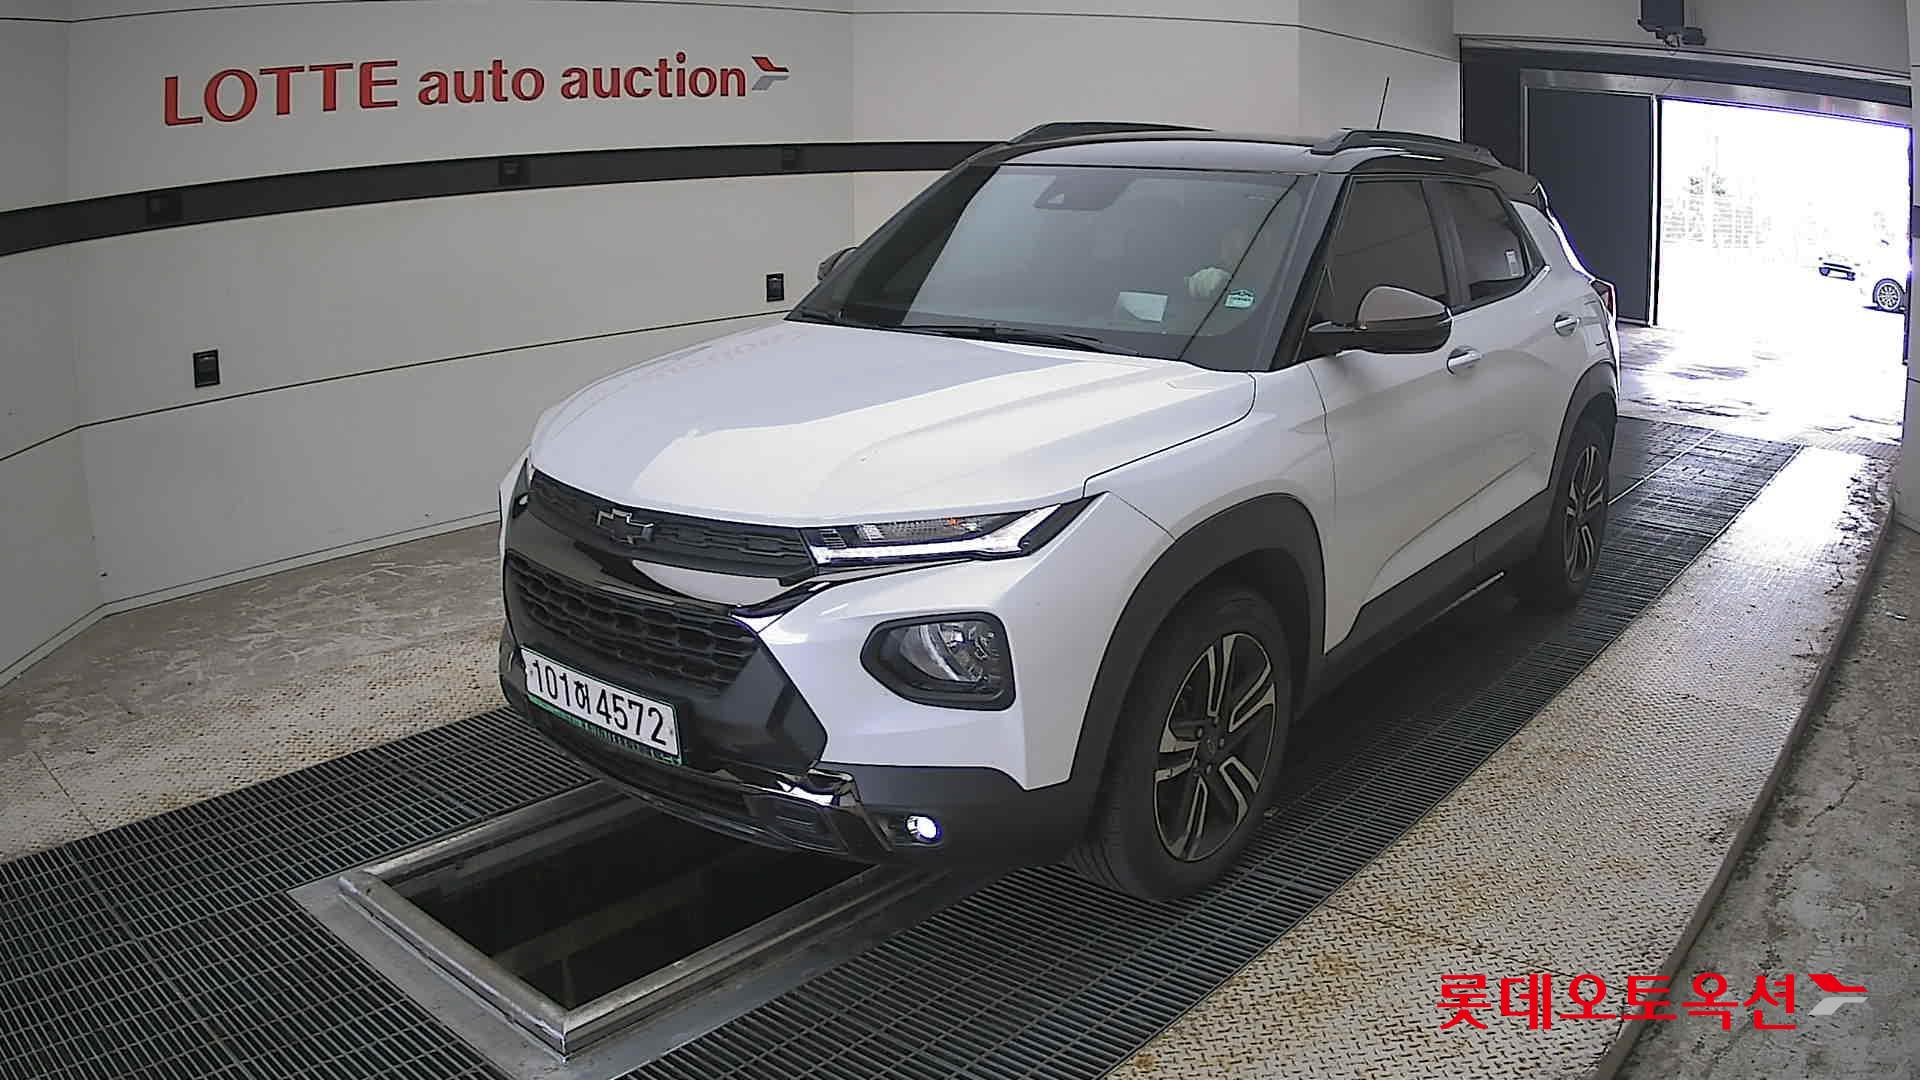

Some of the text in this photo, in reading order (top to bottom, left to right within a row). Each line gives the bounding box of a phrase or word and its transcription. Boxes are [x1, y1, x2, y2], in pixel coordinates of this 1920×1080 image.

[163, 52, 748, 127] LOTTE auto auction
[532, 659, 667, 746] 101허4572
